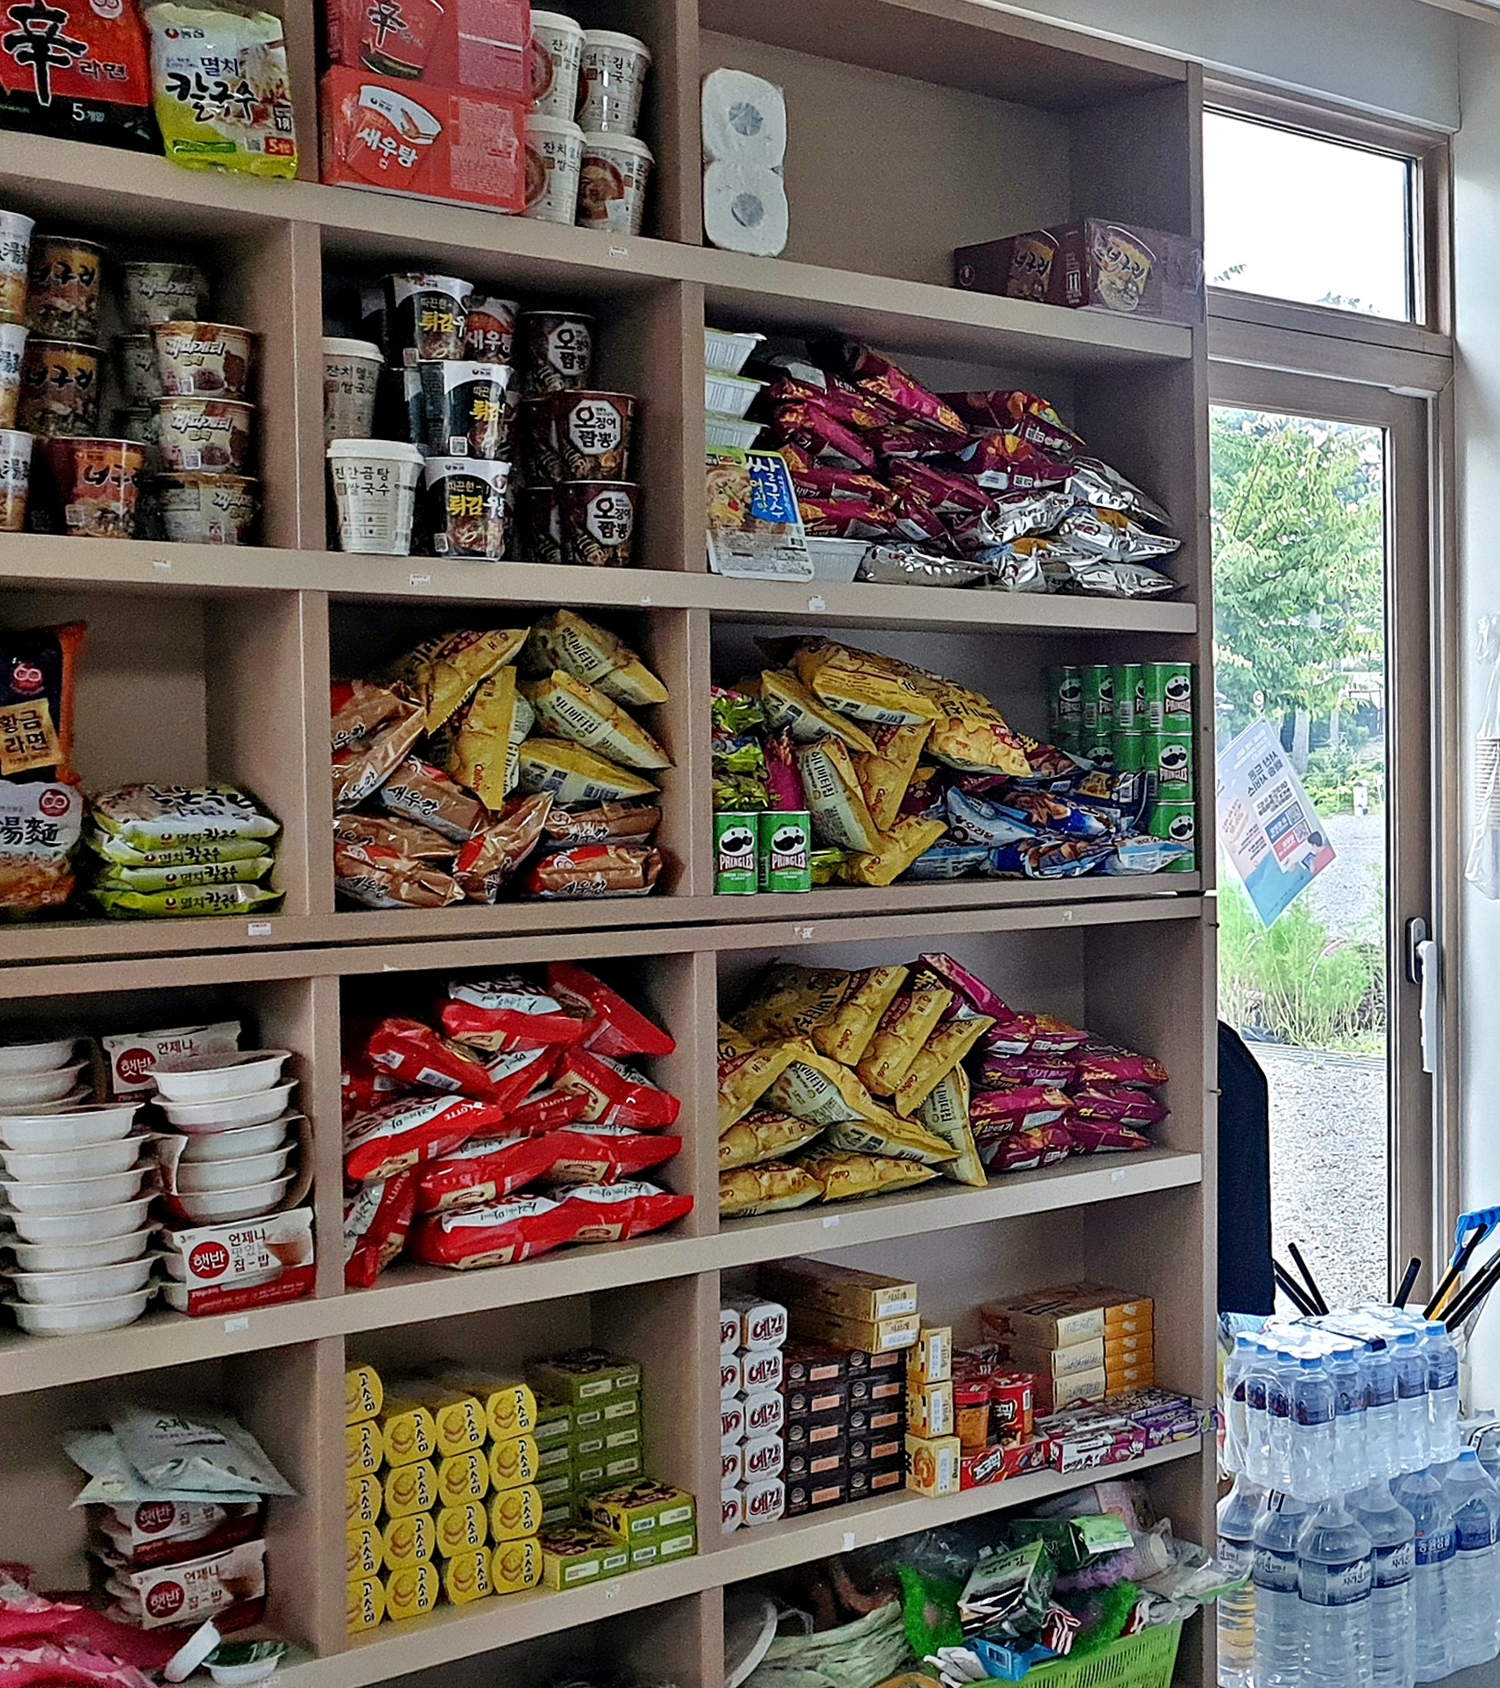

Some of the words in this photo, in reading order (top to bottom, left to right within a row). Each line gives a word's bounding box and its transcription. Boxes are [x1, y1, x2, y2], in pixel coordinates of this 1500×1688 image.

[2, 0, 88, 107] 辛
[201, 56, 240, 77] 멸치
[79, 60, 128, 81] 라면
[165, 72, 258, 122] 칼국수
[357, 127, 419, 171] 새우탕
[419, 311, 465, 338] 튀김우
[165, 341, 226, 360] 짜파게티
[170, 415, 233, 434] 짜파게티
[574, 406, 617, 430] 오징어
[578, 430, 614, 449] 짬뽕
[593, 497, 632, 521] 오징어
[597, 521, 628, 540] 짬뽕
[0, 709, 42, 734] 황금
[5, 731, 49, 755] 라면
[332, 723, 366, 750] 우깡
[389, 785, 440, 817] 새우깡
[185, 846, 221, 861] 칼국수
[718, 854, 755, 871] PRINGLES
[772, 854, 807, 870] PRINGLES
[204, 865, 238, 880] 칼국수
[351, 875, 389, 899] 새우깡
[561, 880, 608, 895] 새우깡
[157, 1039, 195, 1057] 언제나
[120, 1058, 154, 1077] 햇반
[228, 1231, 267, 1248] 언제나
[192, 1251, 226, 1273] 햇반
[359, 1371, 375, 1412] 고소미
[514, 1389, 531, 1429] 고소미
[413, 1413, 429, 1453] 고소미
[465, 1403, 480, 1442] 고소미
[361, 1428, 374, 1468] 고소미
[518, 1439, 532, 1479] 고소미
[416, 1465, 430, 1506] 고소미
[468, 1455, 482, 1495] 고소미
[361, 1479, 373, 1521] 고소미
[522, 1490, 535, 1530] 고소미
[139, 1505, 173, 1527] 햇반
[466, 1505, 479, 1545] 고소미
[362, 1530, 375, 1572] 고소미
[415, 1518, 428, 1559] 고소미
[184, 1565, 220, 1583] 언제나
[475, 1552, 489, 1592] 고소미
[523, 1543, 535, 1584] 고소미
[151, 1590, 180, 1612] 햇반
[418, 1567, 429, 1609] 고소미
[363, 1582, 375, 1623] 고소미
